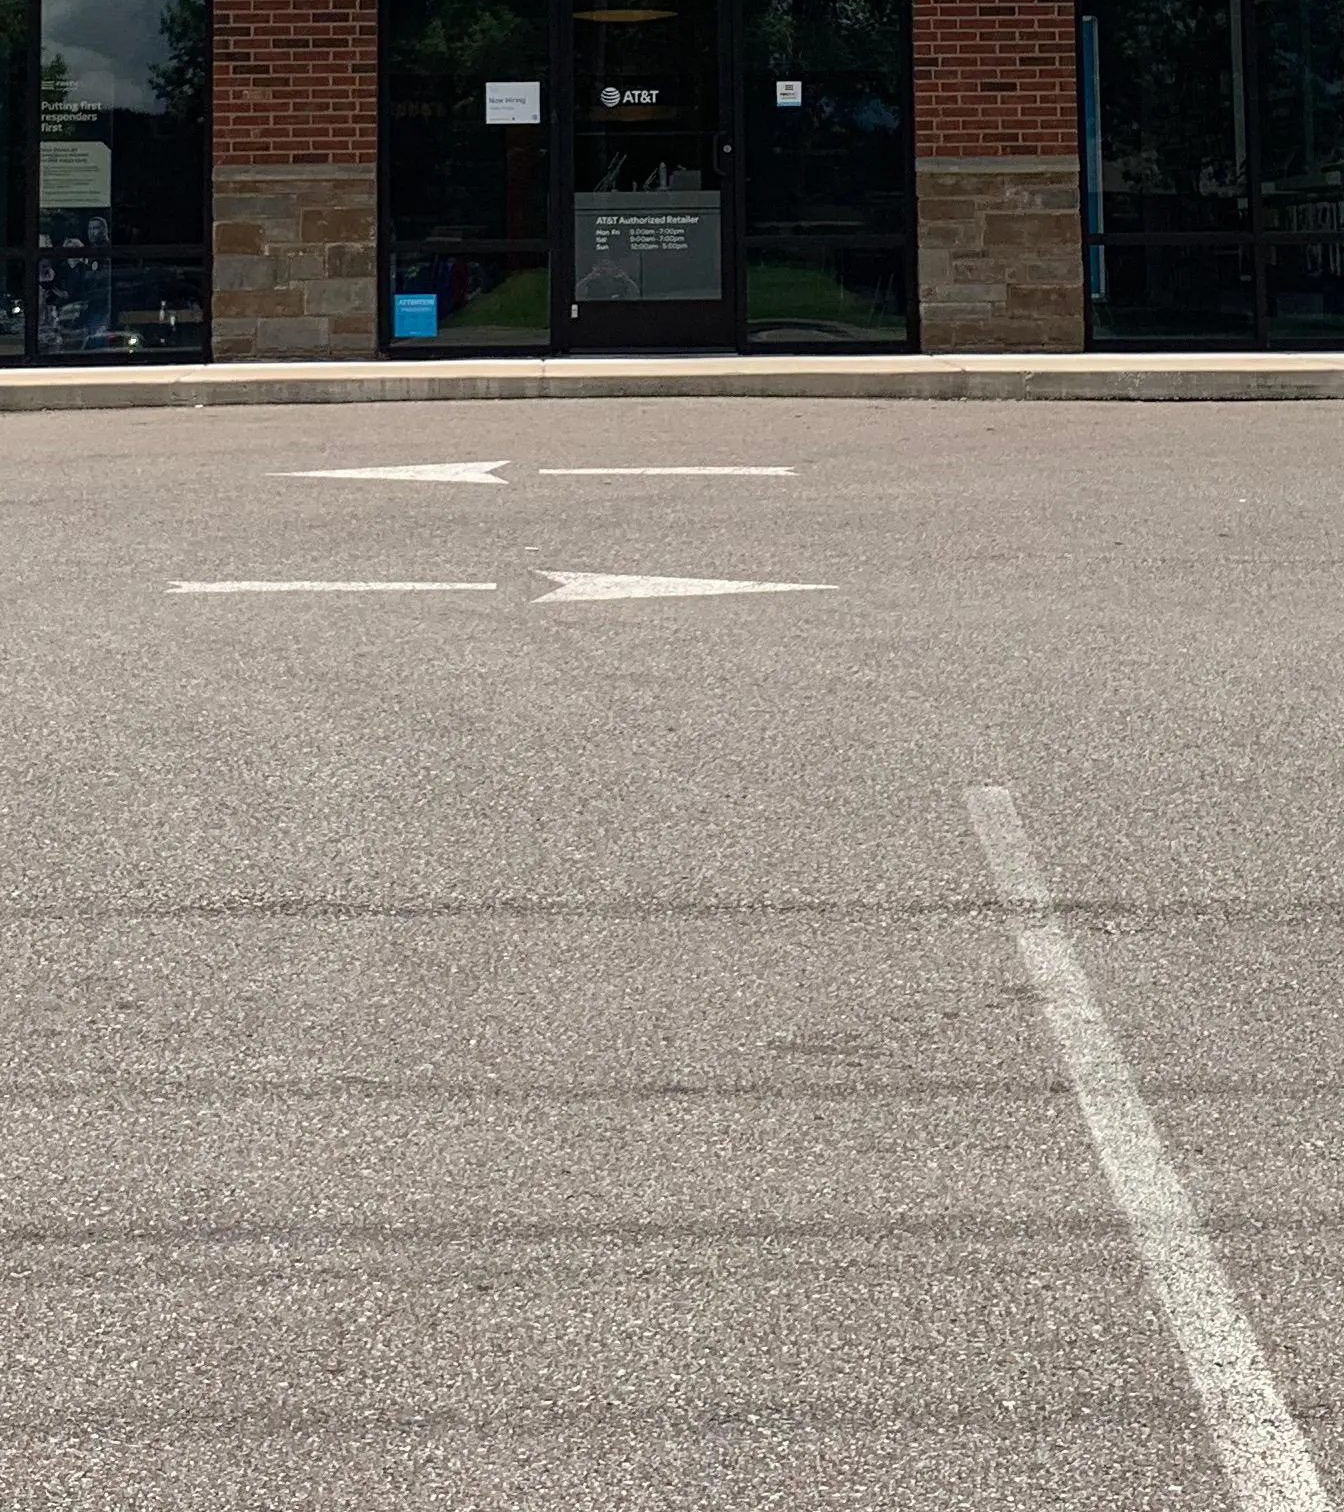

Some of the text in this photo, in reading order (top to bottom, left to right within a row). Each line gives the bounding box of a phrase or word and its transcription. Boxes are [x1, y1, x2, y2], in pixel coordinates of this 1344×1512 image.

[622, 90, 660, 104] AT&T
[41, 100, 102, 112] Putting first
[41, 112, 98, 123] responders
[41, 122, 63, 132] first
[596, 216, 699, 225] AT&T Authorized Retailer
